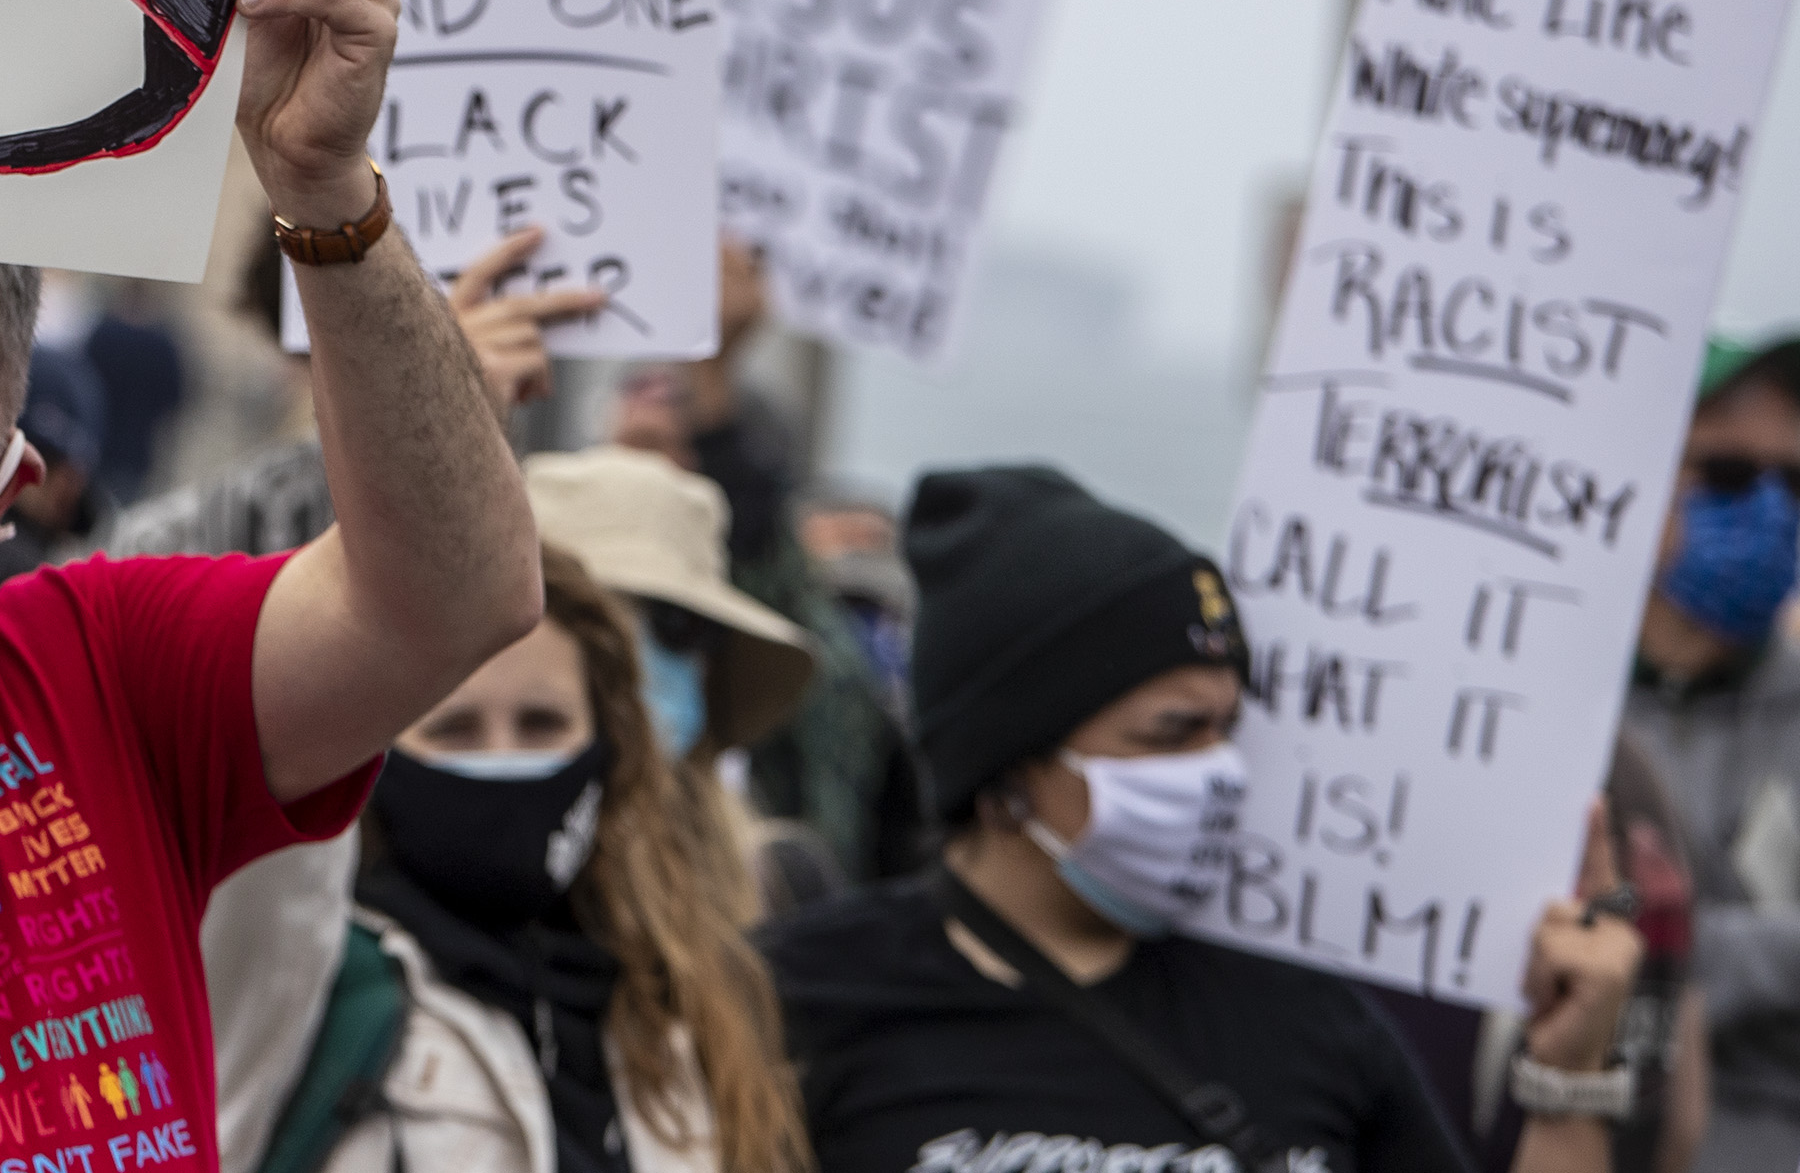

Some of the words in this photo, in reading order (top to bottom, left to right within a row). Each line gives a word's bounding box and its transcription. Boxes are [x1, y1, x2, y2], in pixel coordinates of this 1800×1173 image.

[384, 86, 638, 165] LACK
[416, 167, 601, 237] IVES
[1315, 238, 1668, 380] RACIST
[1228, 500, 1417, 628] CALL
[1466, 574, 1587, 658] IT
[1447, 688, 1527, 762] IT
[108, 1118, 197, 1173] FAKE
